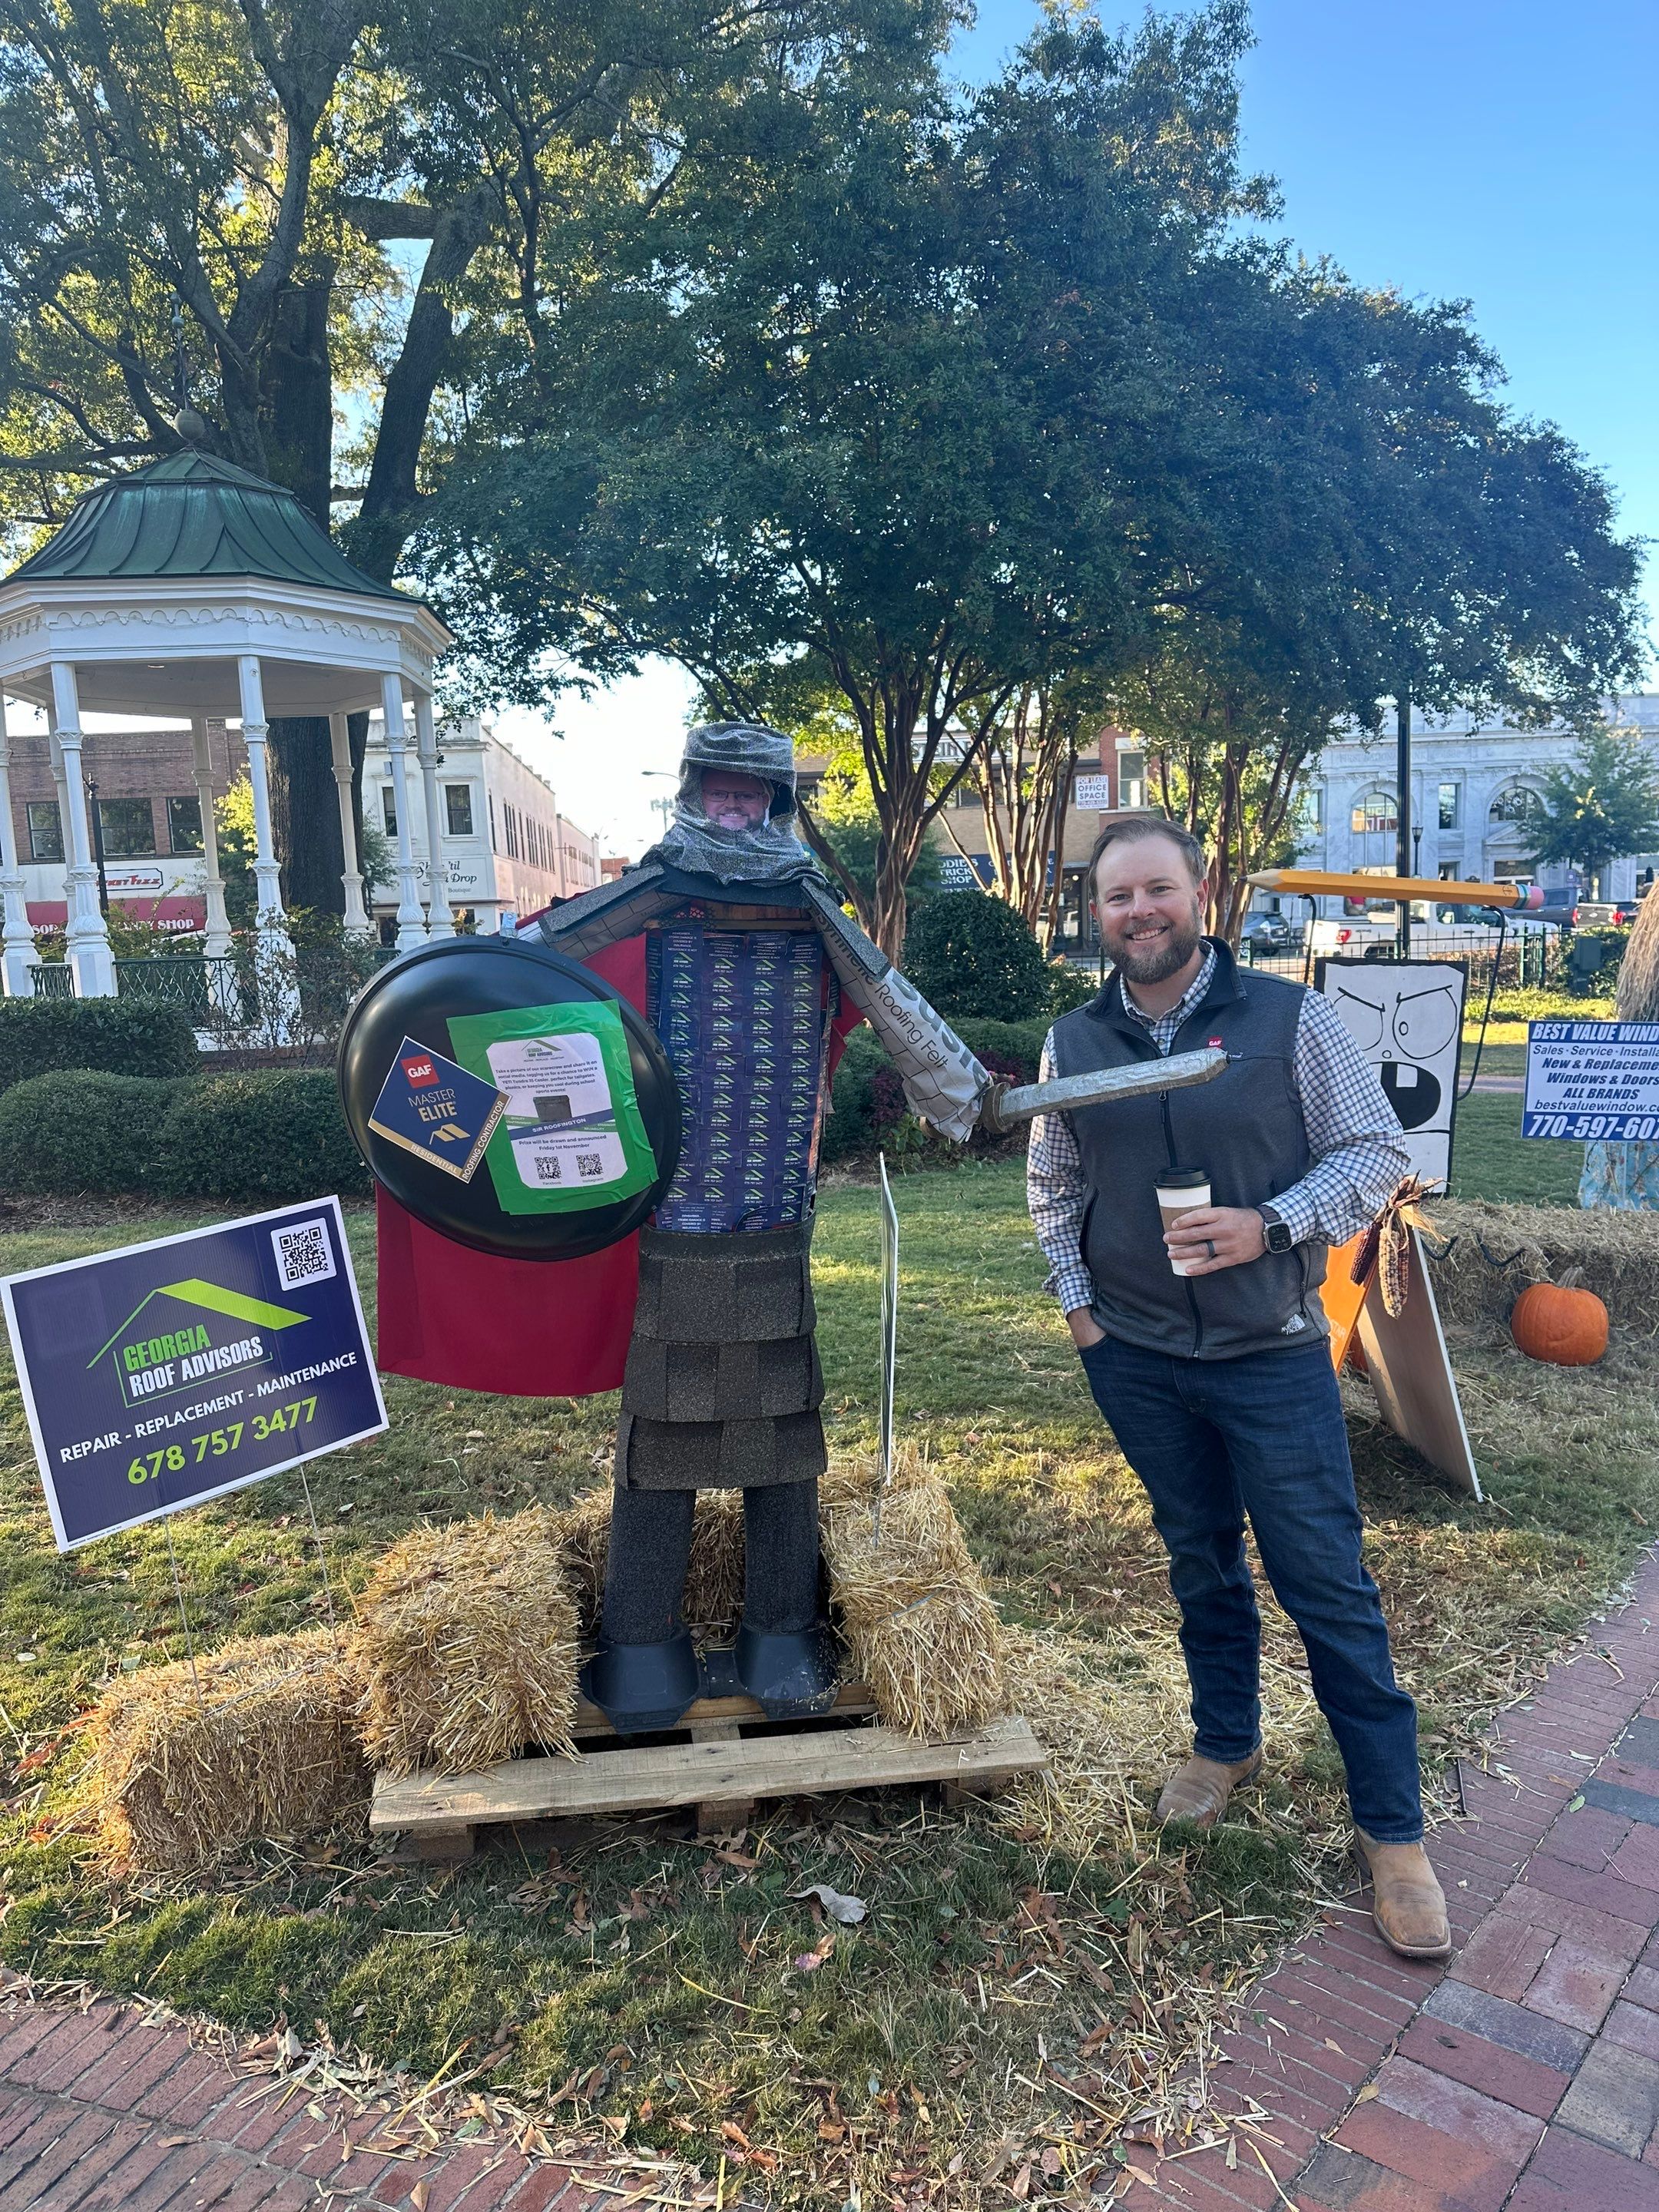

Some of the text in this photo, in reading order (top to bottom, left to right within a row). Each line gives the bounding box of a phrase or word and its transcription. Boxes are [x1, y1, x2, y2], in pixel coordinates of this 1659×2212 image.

[450, 873, 477, 884] Drop
[941, 876, 972, 884] SHOP
[157, 919, 194, 930] SHOP
[875, 984, 924, 1044] Roofing
[921, 1040, 949, 1068] Felt
[1532, 1023, 1571, 1040] BEST
[1572, 1024, 1616, 1041] VALUE
[1533, 1045, 1564, 1055] Sales
[1570, 1045, 1613, 1056] Service
[407, 1064, 433, 1078] GAF
[1542, 1058, 1570, 1069] New
[1572, 1059, 1581, 1069] &
[1546, 1072, 1608, 1084] Windows
[1609, 1075, 1619, 1084] &
[408, 1088, 455, 1107] MASTER
[1563, 1088, 1641, 1100] ALL BRANDS
[418, 1102, 457, 1122] ELITE
[544, 1118, 586, 1130] ROOFINGTON
[462, 1101, 505, 1180] ROOFING CONTRACTOR
[411, 1144, 458, 1174] RESIDENTIAL
[123, 1324, 211, 1371] GEORGIA
[129, 1336, 263, 1398] ROOF ADVISORS
[60, 1432, 122, 1462] REPAIR
[134, 1390, 244, 1438] REPLACEMENT
[257, 1352, 357, 1397] MAINTENANCE
[127, 1396, 318, 1485] 678 757 3477
